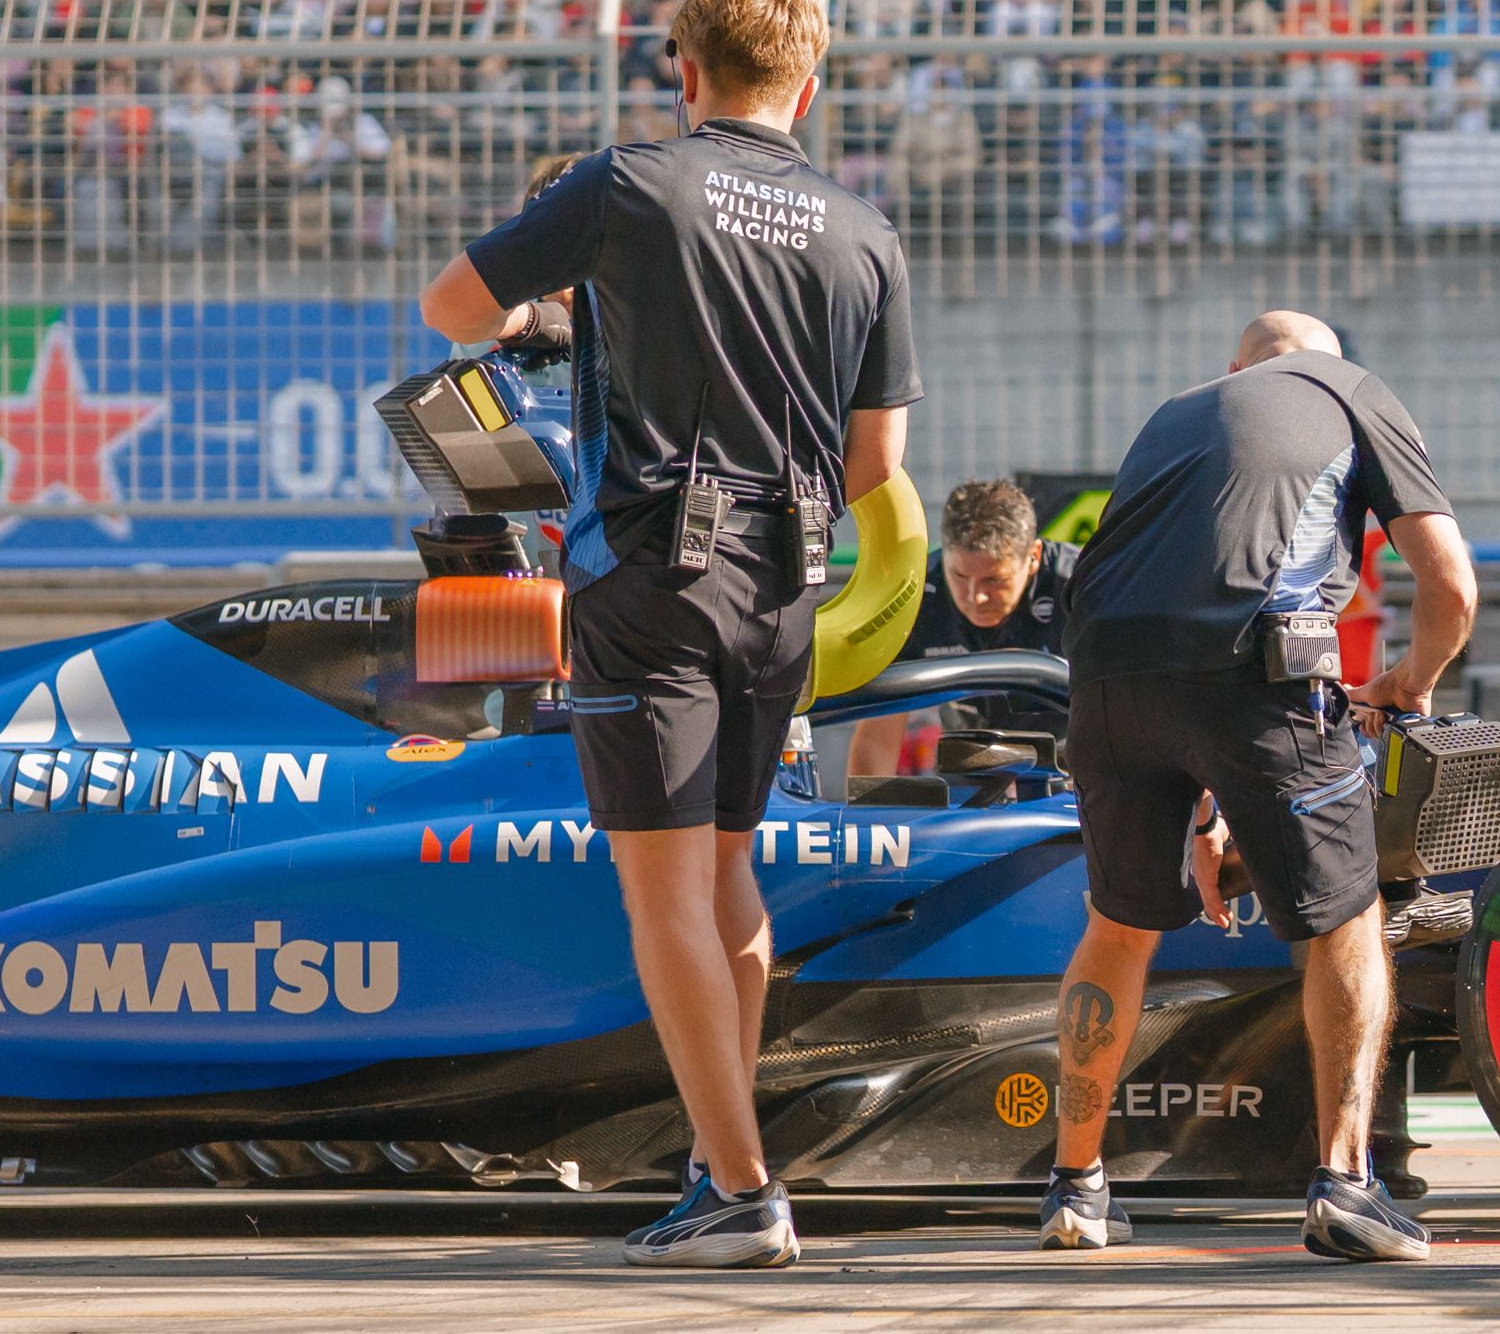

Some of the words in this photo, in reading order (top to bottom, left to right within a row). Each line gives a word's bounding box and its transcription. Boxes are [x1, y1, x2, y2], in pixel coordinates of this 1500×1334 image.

[704, 188, 825, 233] WILLIAMS
[705, 170, 826, 214] ATLASSIAN
[716, 212, 808, 250] RACING
[219, 596, 390, 623] DURACELL
